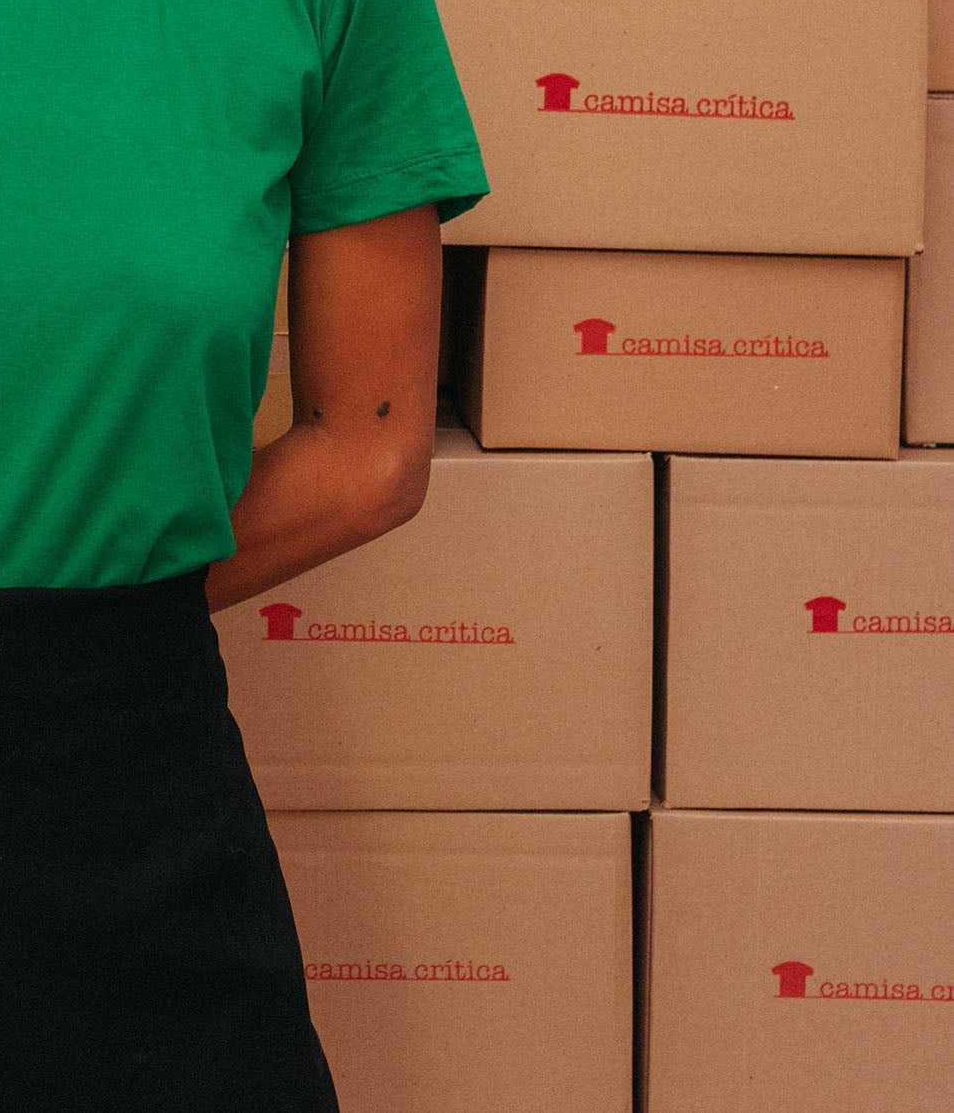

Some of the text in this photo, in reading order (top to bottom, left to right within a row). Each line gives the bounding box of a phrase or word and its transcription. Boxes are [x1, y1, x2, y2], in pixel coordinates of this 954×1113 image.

[582, 92, 795, 121] camisa crítica
[620, 335, 830, 359] camisa crítica
[306, 621, 515, 645] camisa crítica
[850, 611, 954, 635] camisa
[304, 959, 510, 982] camisa crítica
[818, 979, 926, 1002] camisa
